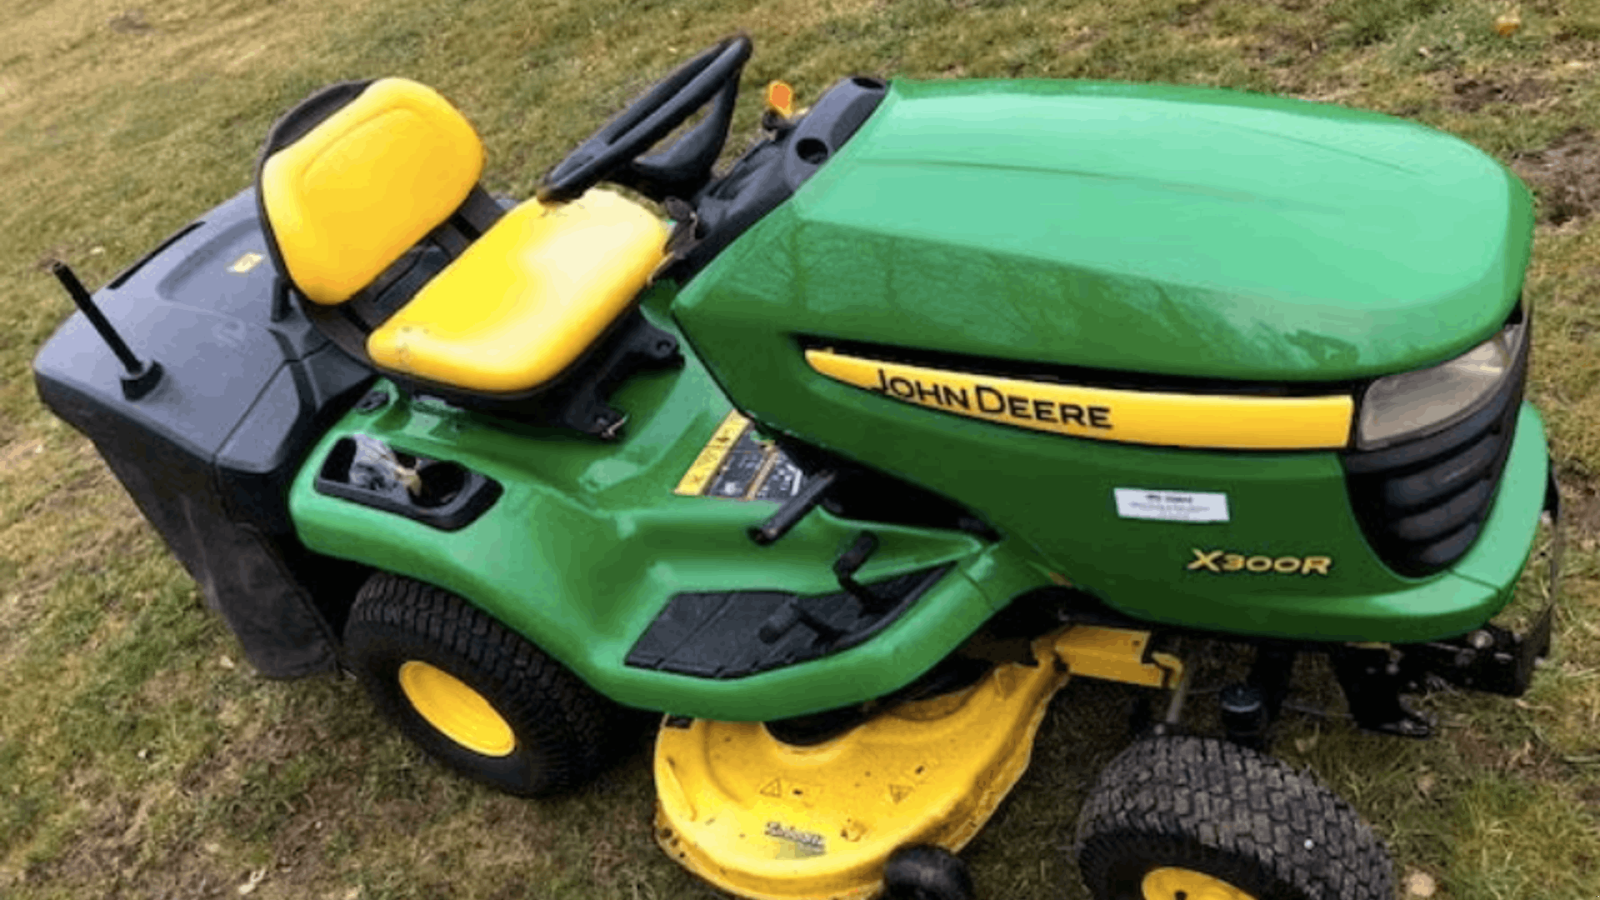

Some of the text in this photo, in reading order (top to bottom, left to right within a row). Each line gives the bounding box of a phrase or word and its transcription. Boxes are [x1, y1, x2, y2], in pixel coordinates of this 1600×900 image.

[872, 368, 1112, 429] JOHN DEERE
[1187, 548, 1331, 575] X300R
